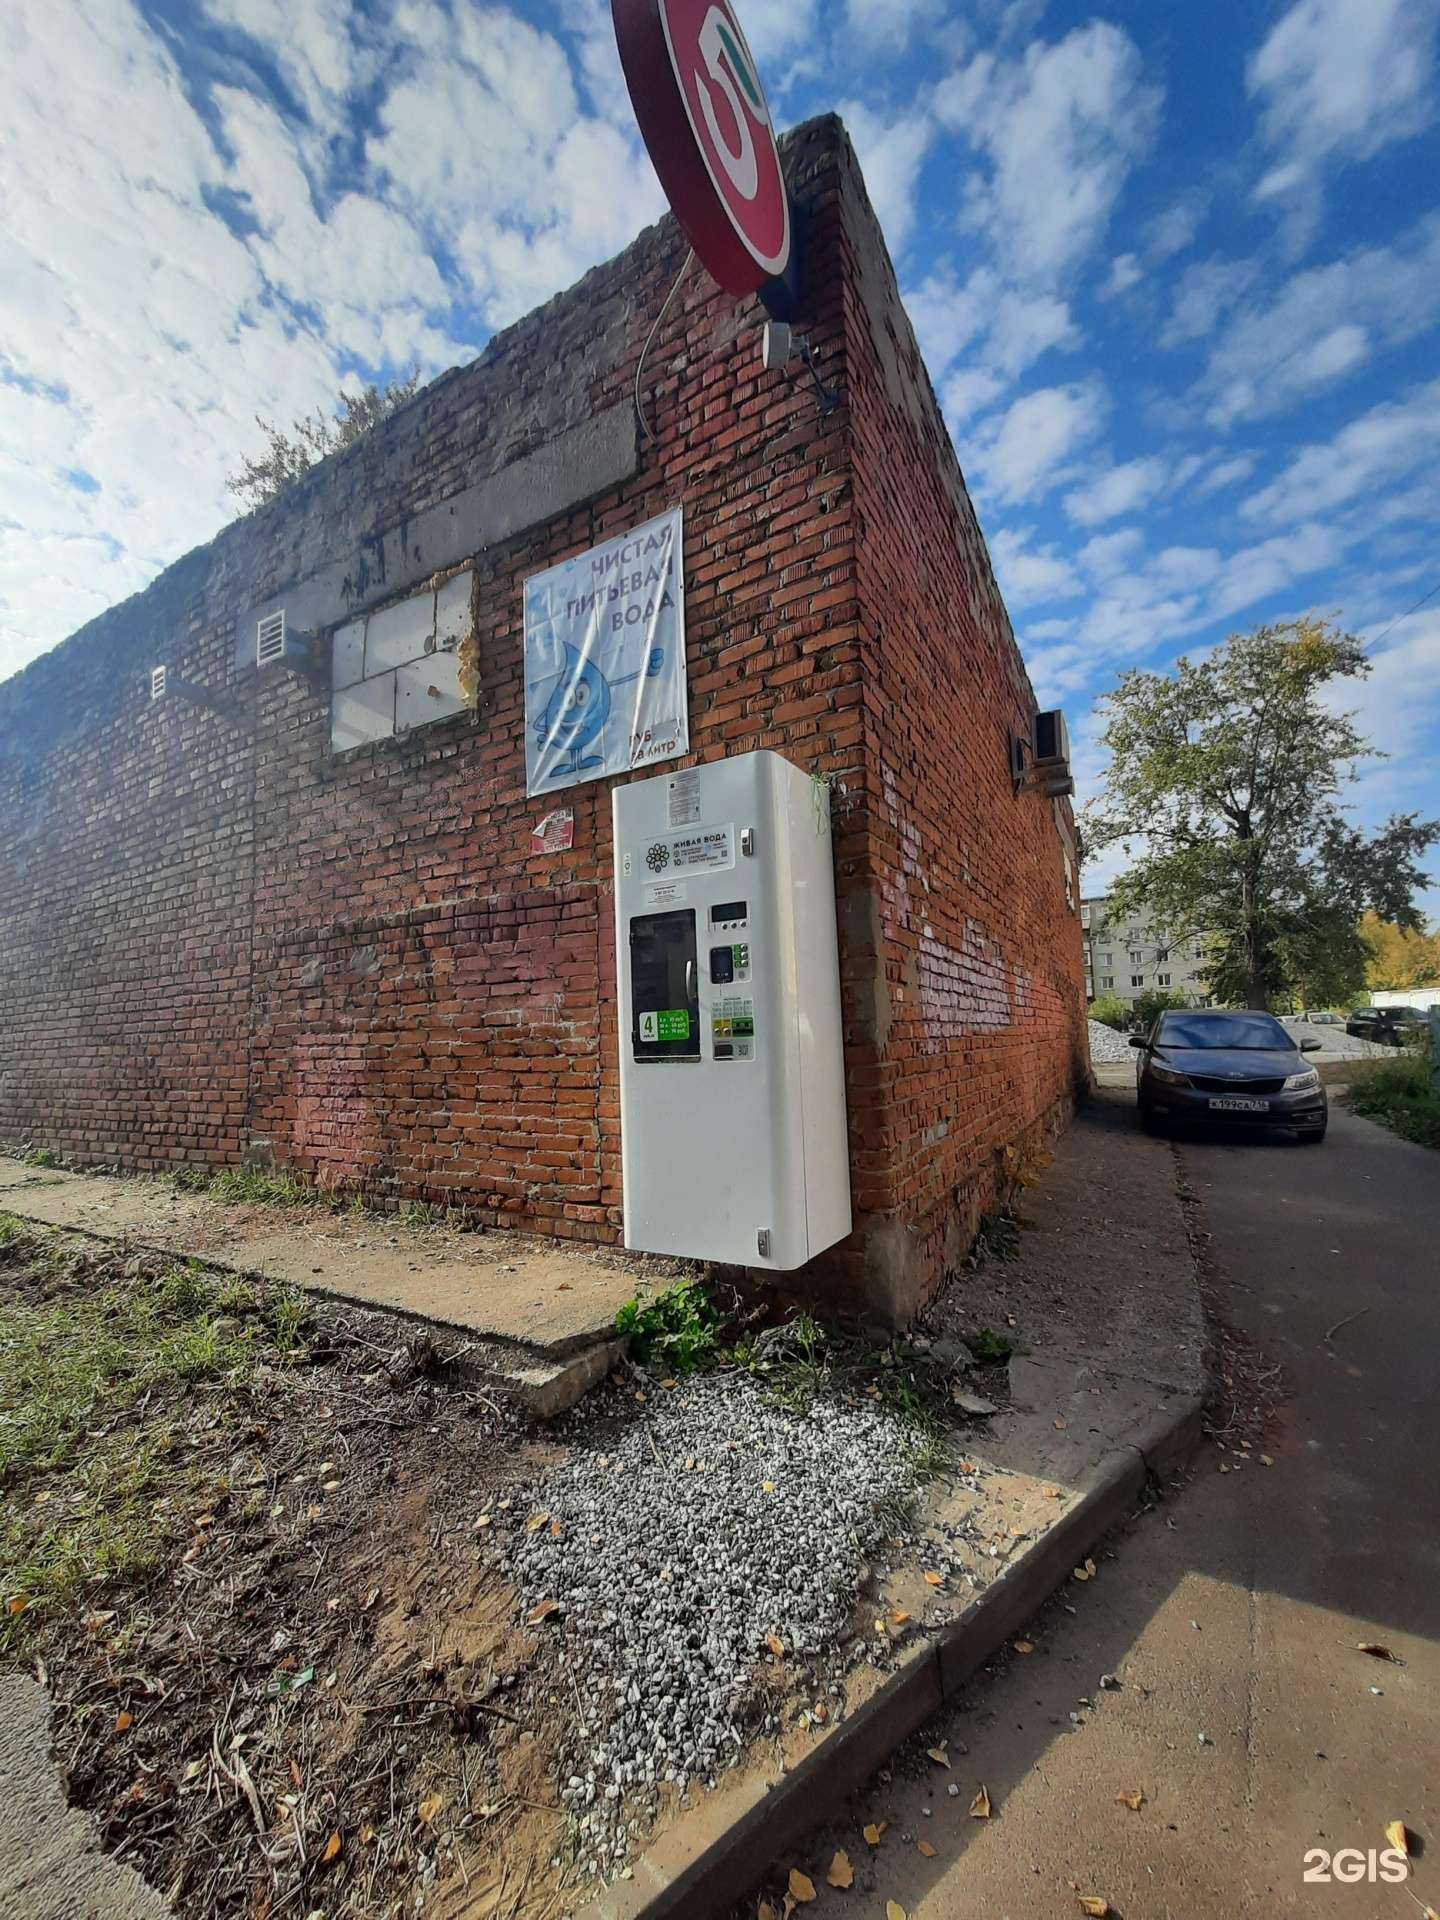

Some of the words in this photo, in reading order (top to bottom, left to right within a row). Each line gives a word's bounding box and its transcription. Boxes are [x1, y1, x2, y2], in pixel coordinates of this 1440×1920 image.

[592, 524, 673, 577] ЧИСТАЯ
[612, 590, 676, 632] ВОДА
[703, 833, 727, 843] ВОДА
[644, 1015, 653, 1033] 4
